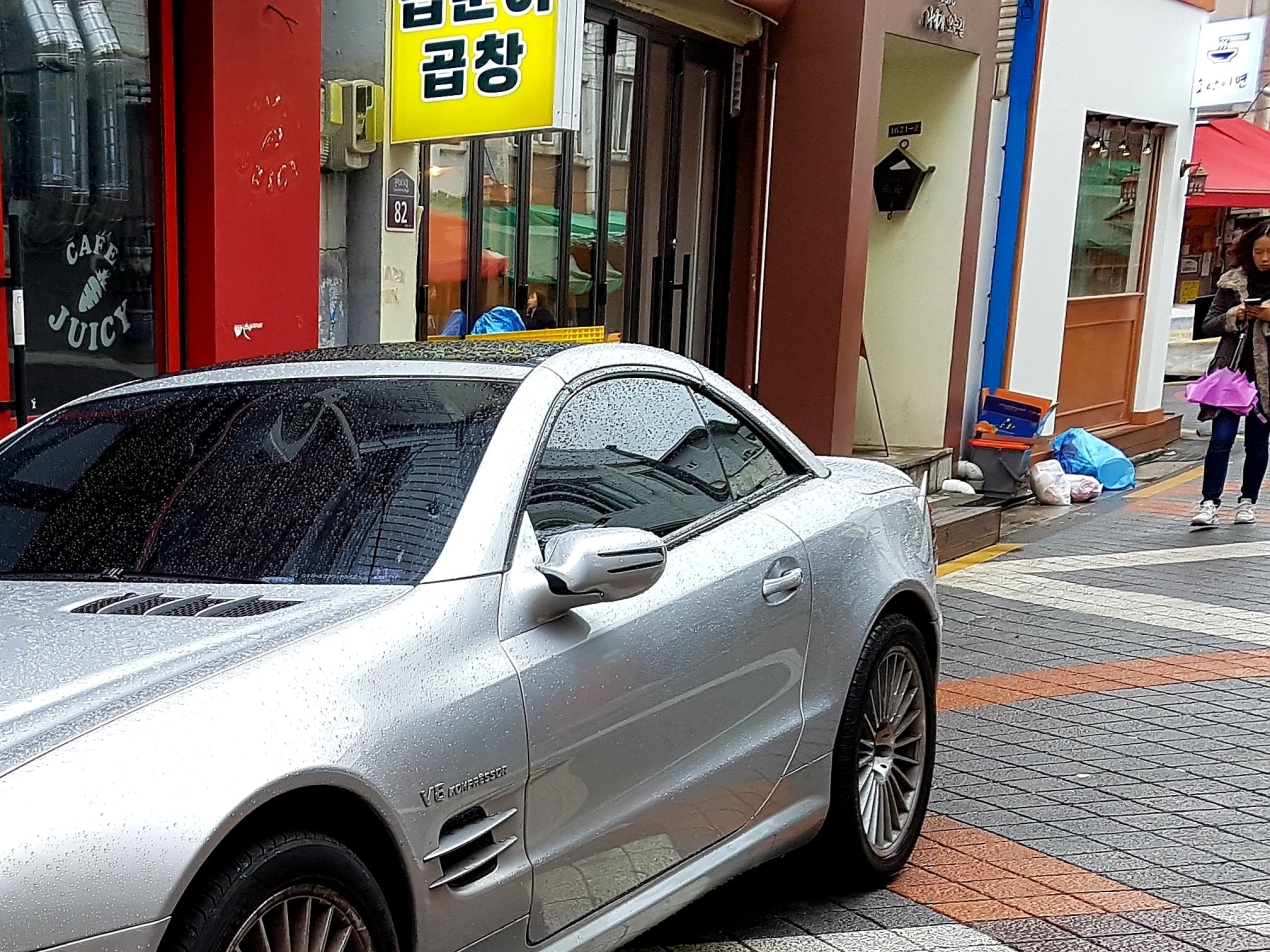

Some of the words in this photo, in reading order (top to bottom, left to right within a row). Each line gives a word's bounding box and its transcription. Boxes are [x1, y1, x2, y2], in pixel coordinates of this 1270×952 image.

[421, 31, 525, 99] 곱창
[394, 200, 408, 224] 82
[48, 298, 131, 351] JUICY
